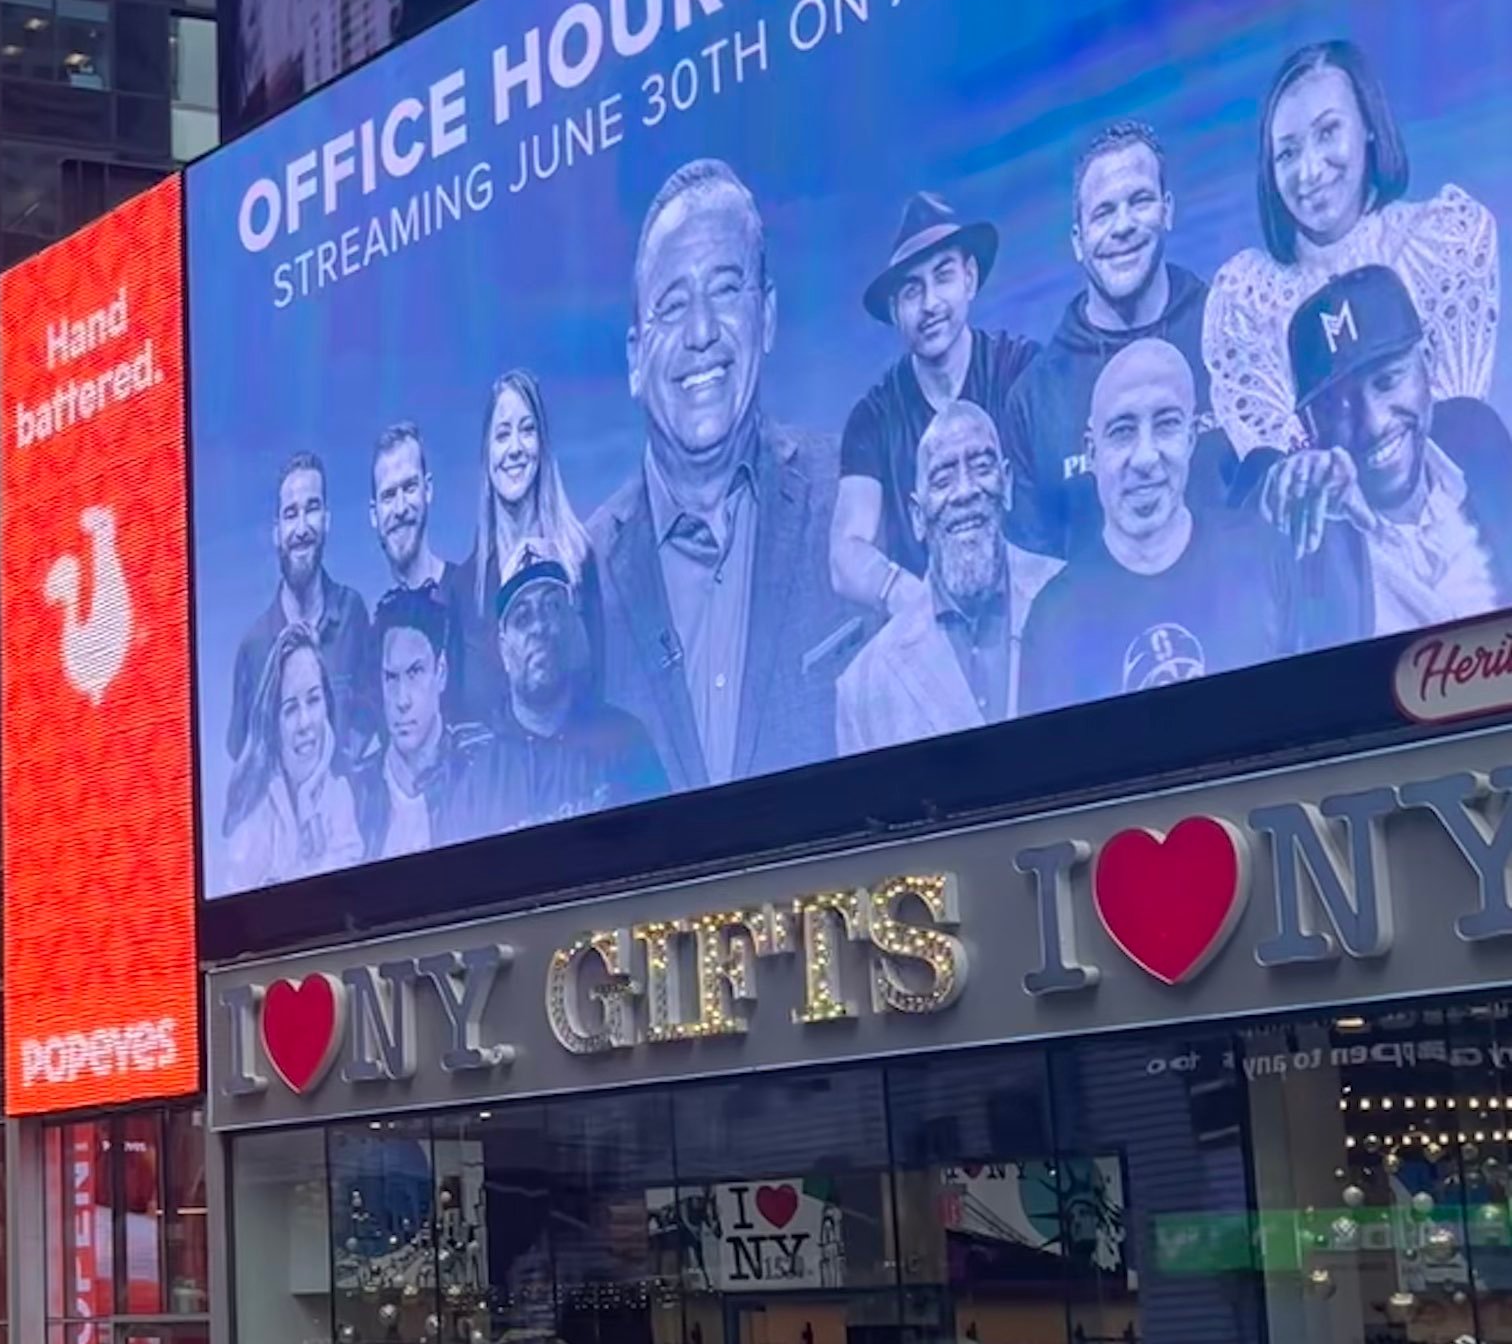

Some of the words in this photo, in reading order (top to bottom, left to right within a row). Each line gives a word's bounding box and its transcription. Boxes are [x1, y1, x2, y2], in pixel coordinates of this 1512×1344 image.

[238, 68, 468, 254] OFFICE
[273, 161, 493, 309] STREAMING
[509, 93, 625, 193] JUNE
[641, 18, 768, 126] 30TH
[15, 338, 165, 449] battered.
[45, 286, 129, 371] Hand
[342, 943, 516, 1083] NY
[546, 870, 970, 1054] GIFTS
[1013, 840, 1099, 996] I
[1249, 768, 1512, 967] NY
[726, 1233, 810, 1280] NY
